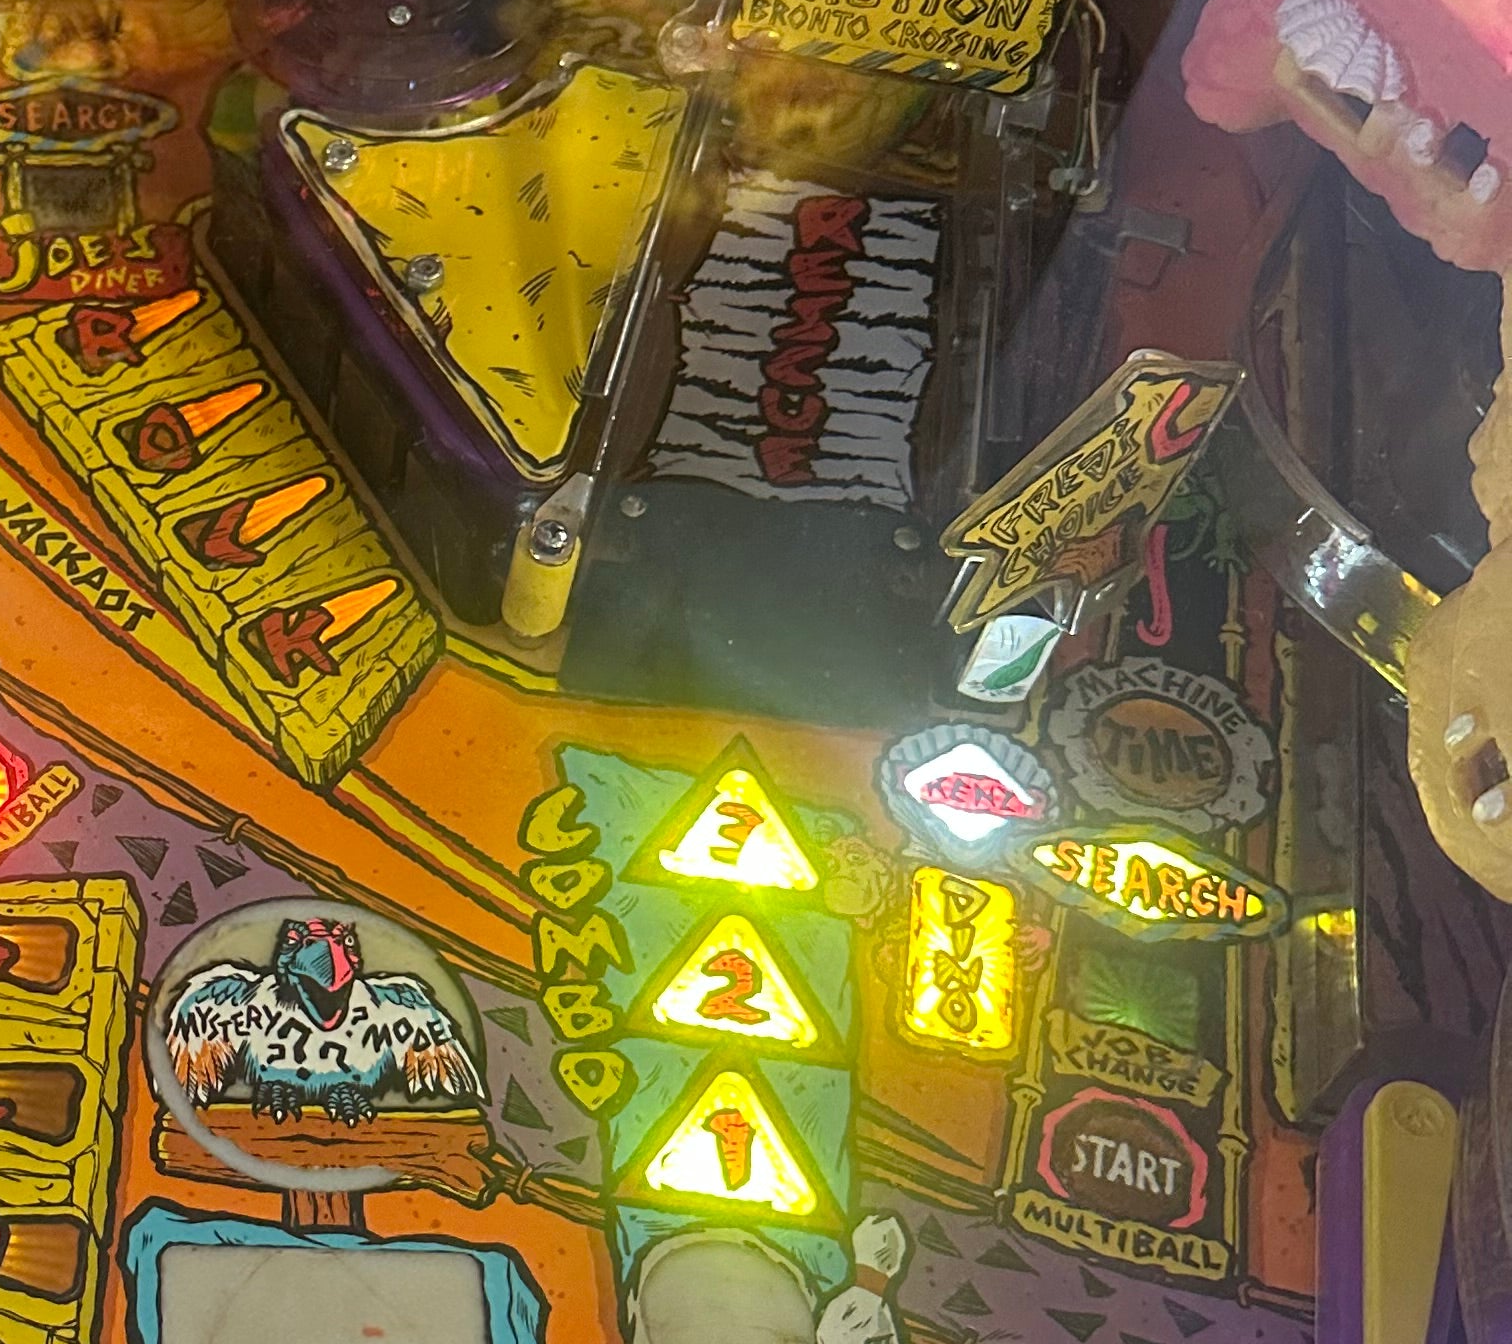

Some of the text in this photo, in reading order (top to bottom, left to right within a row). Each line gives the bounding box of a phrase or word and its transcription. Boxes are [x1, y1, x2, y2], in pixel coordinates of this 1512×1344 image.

[879, 18, 1033, 67] CROSSING
[69, 266, 166, 296] DINER
[754, 194, 872, 488] RESCUE
[71, 304, 342, 688] ROCK
[989, 414, 1143, 546] FRED'S
[996, 460, 1143, 589] CHOICE
[1076, 660, 1248, 738] MACHINE
[1099, 716, 1223, 785] TIME
[1050, 838, 1254, 924] SEARCH
[518, 782, 638, 1116] COMBO
[697, 946, 772, 1026] 2
[933, 874, 992, 1035] DINO
[173, 1004, 452, 1053] MYSTERY MODE
[1064, 1044, 1201, 1097] CHANGE
[702, 1108, 757, 1191] 1
[1070, 1132, 1183, 1196] START
[1023, 1199, 1222, 1271] MULTIBALL
